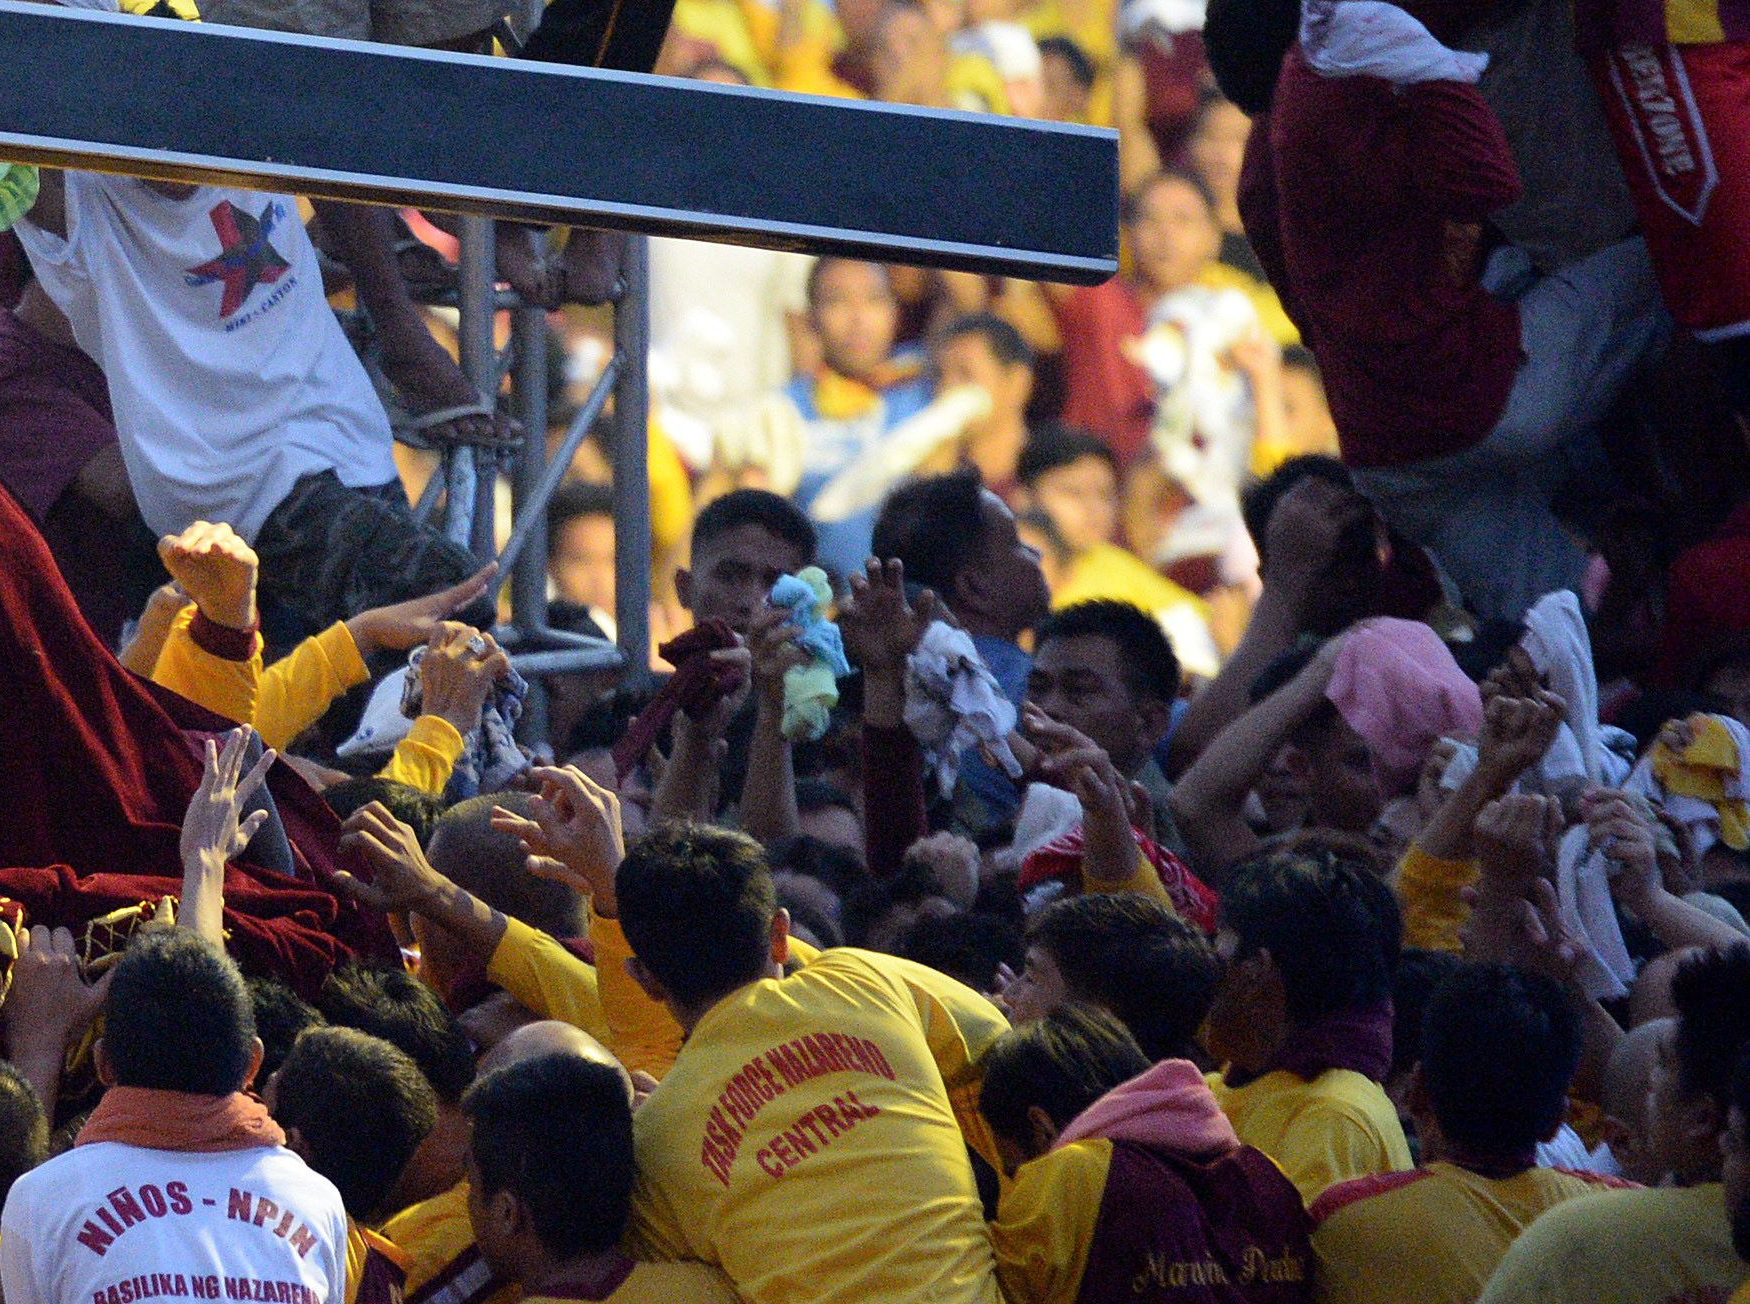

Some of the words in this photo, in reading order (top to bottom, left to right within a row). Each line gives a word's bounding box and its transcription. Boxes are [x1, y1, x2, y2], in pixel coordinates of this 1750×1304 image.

[718, 1056, 784, 1131] FORCE
[765, 1032, 896, 1088] NAZARENO
[701, 1104, 743, 1188] TASK
[756, 1089, 880, 1179] CENTRAL
[77, 1181, 193, 1257] NIÑOS
[228, 1187, 318, 1259] NPJN
[93, 1273, 190, 1304] BASILIKA
[192, 1275, 220, 1300] NG
